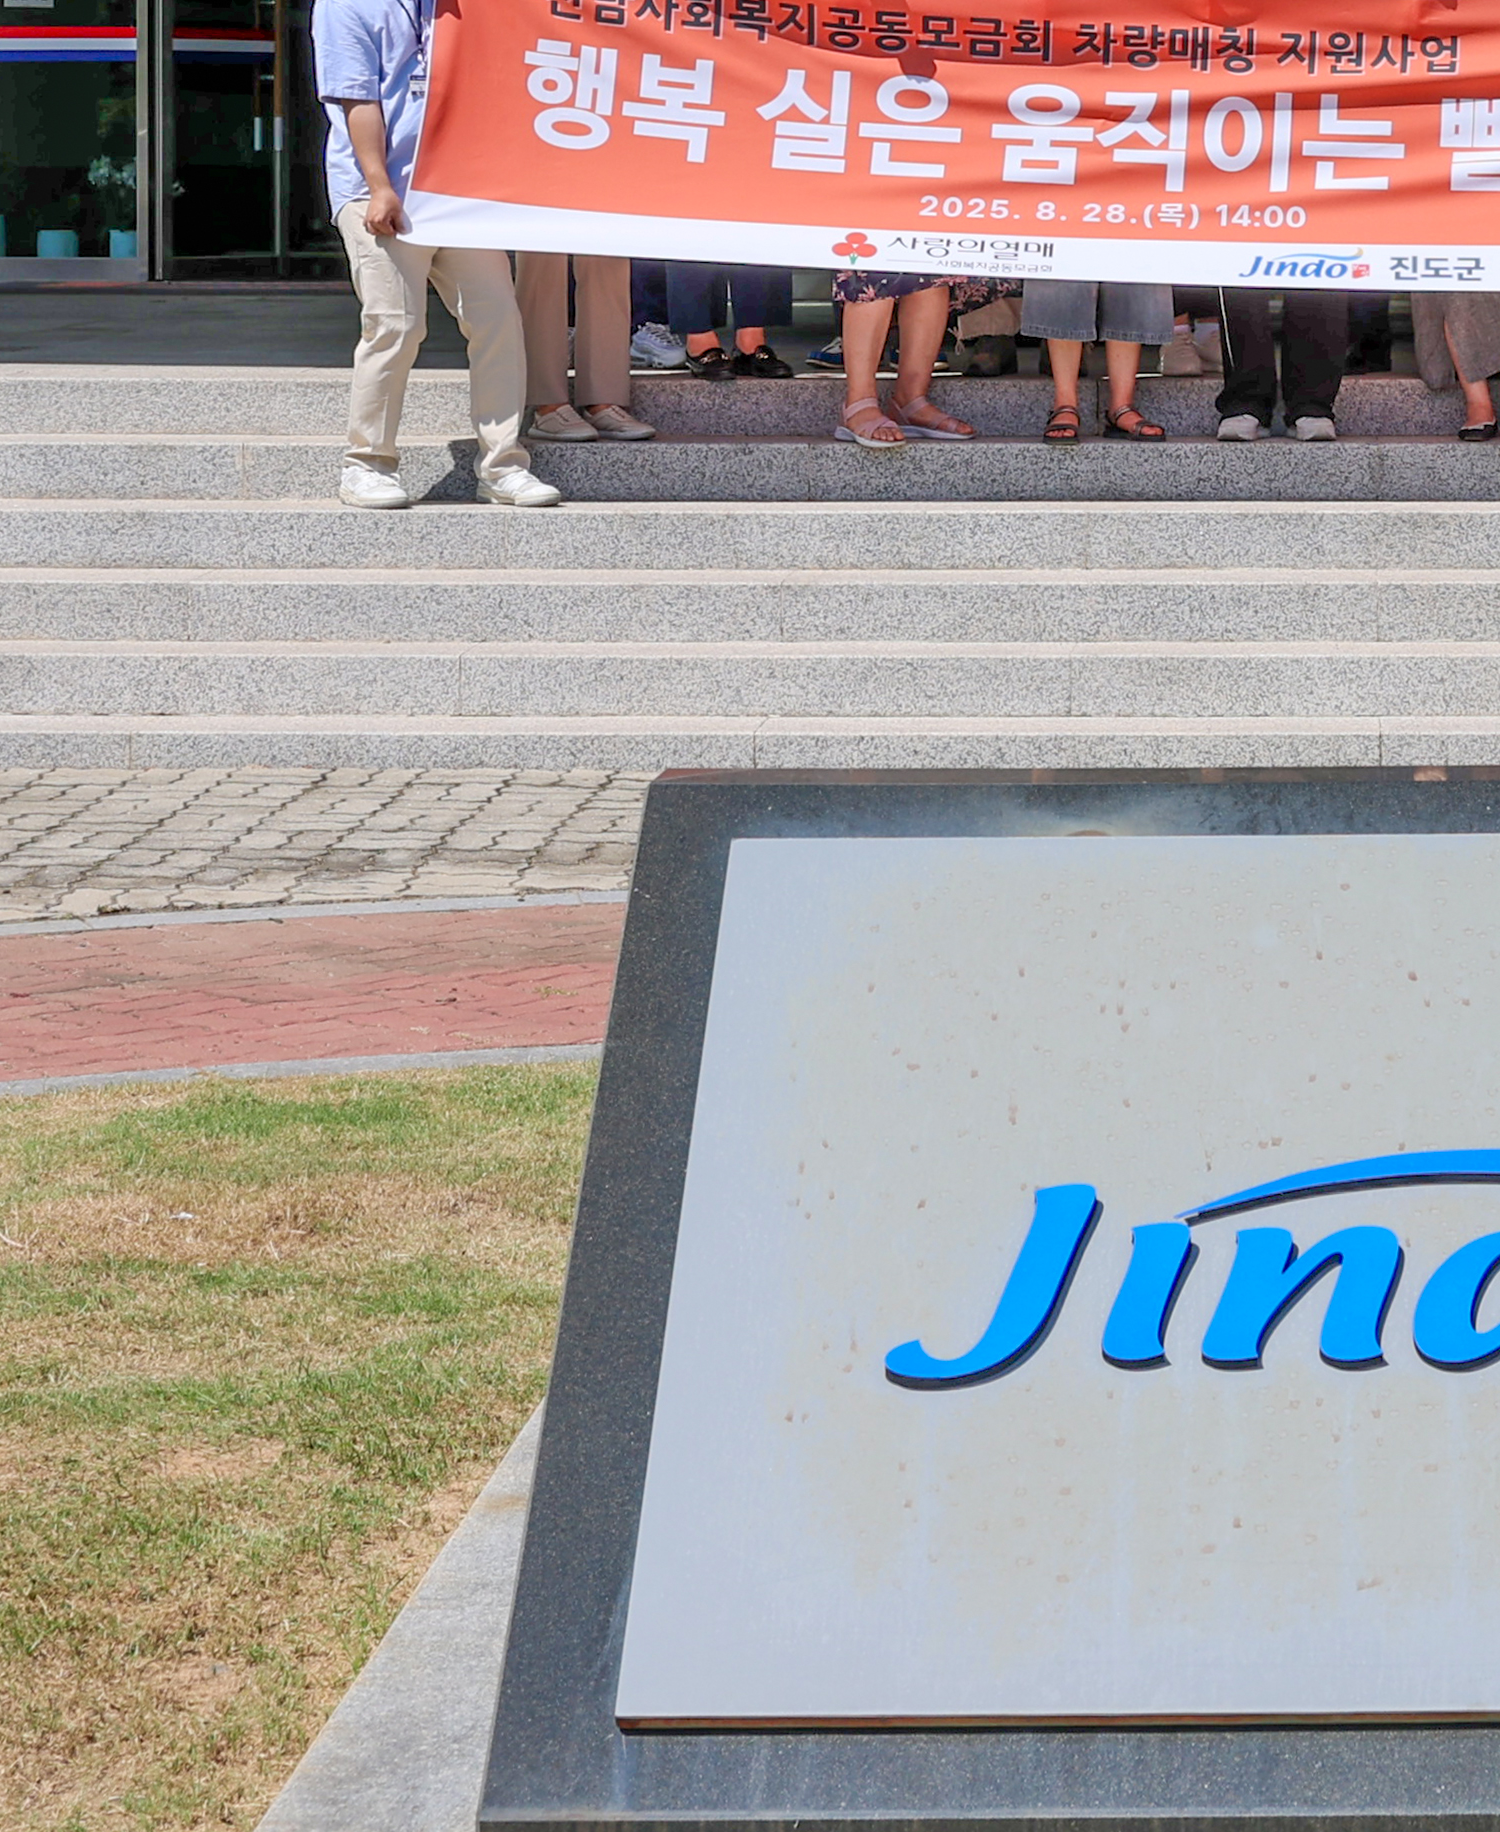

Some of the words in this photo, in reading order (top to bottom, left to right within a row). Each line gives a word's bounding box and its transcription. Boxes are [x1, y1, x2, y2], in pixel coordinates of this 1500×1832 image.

[1072, 24, 1257, 74] 차량매칭
[1277, 31, 1460, 75] 지원사업
[524, 38, 726, 163] 행복
[756, 69, 962, 178] 실은
[991, 83, 1405, 192] 움직이는
[919, 195, 1020, 221] 2025.
[1036, 201, 1067, 221] 8.
[1082, 202, 1200, 229] 28.(목)
[1215, 204, 1307, 228] 14:00
[887, 237, 1055, 259] 사랑의열매
[1239, 255, 1349, 278] Jindo
[1390, 255, 1485, 281] 진도군
